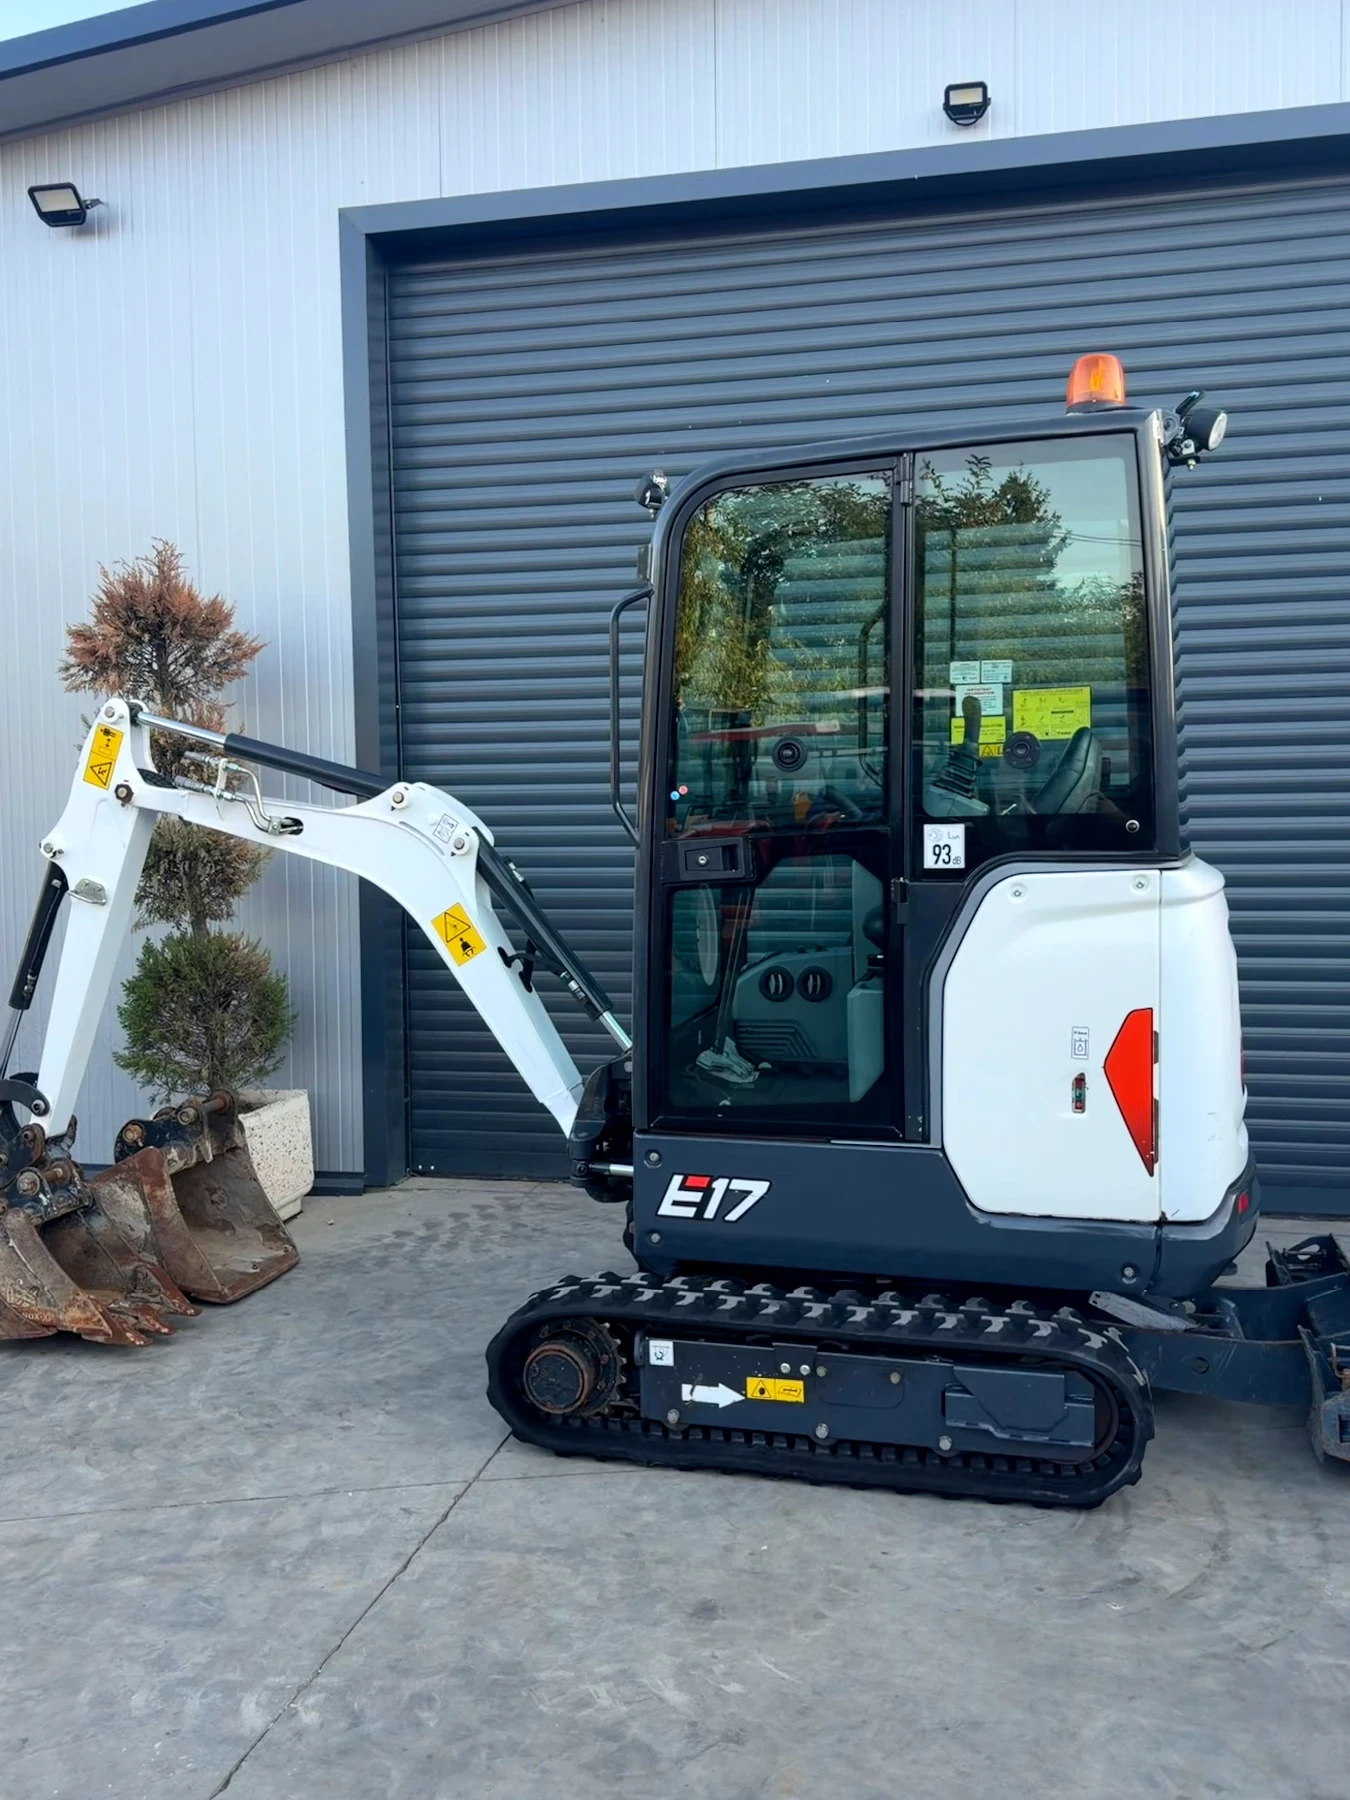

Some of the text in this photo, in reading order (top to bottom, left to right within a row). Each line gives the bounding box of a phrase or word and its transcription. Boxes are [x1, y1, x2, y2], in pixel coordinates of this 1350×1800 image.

[932, 843, 962, 865] 93 dB
[657, 1174, 771, 1222] E17
